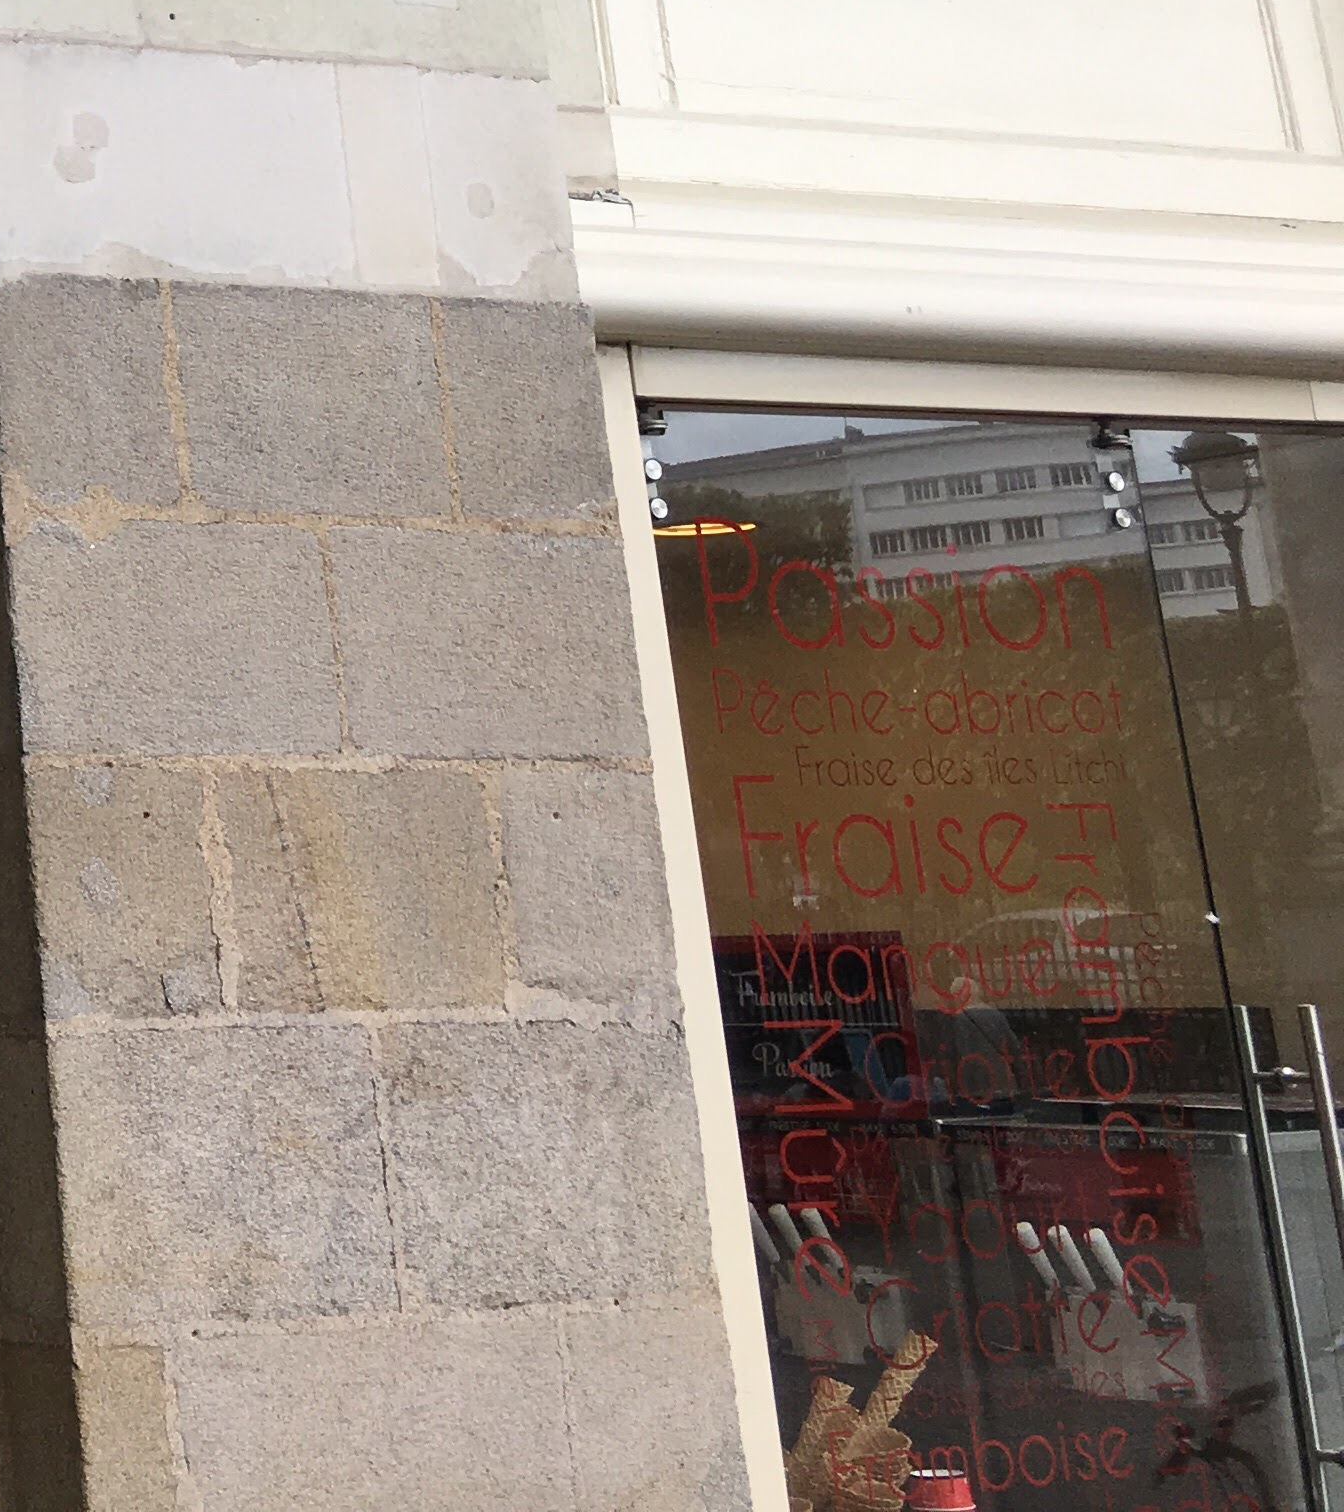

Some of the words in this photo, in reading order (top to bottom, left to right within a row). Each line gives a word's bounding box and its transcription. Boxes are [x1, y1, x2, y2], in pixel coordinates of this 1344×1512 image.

[695, 515, 1114, 651] Passion
[792, 745, 895, 787] Fraise
[912, 745, 973, 786] des
[1049, 747, 1130, 786] Litchi
[732, 775, 1040, 899] Fraise
[752, 920, 1061, 1015] Mangue
[1046, 801, 1171, 1314] Framboise
[763, 1019, 854, 1301] Mûre
[828, 1414, 1136, 1511] Framboise
